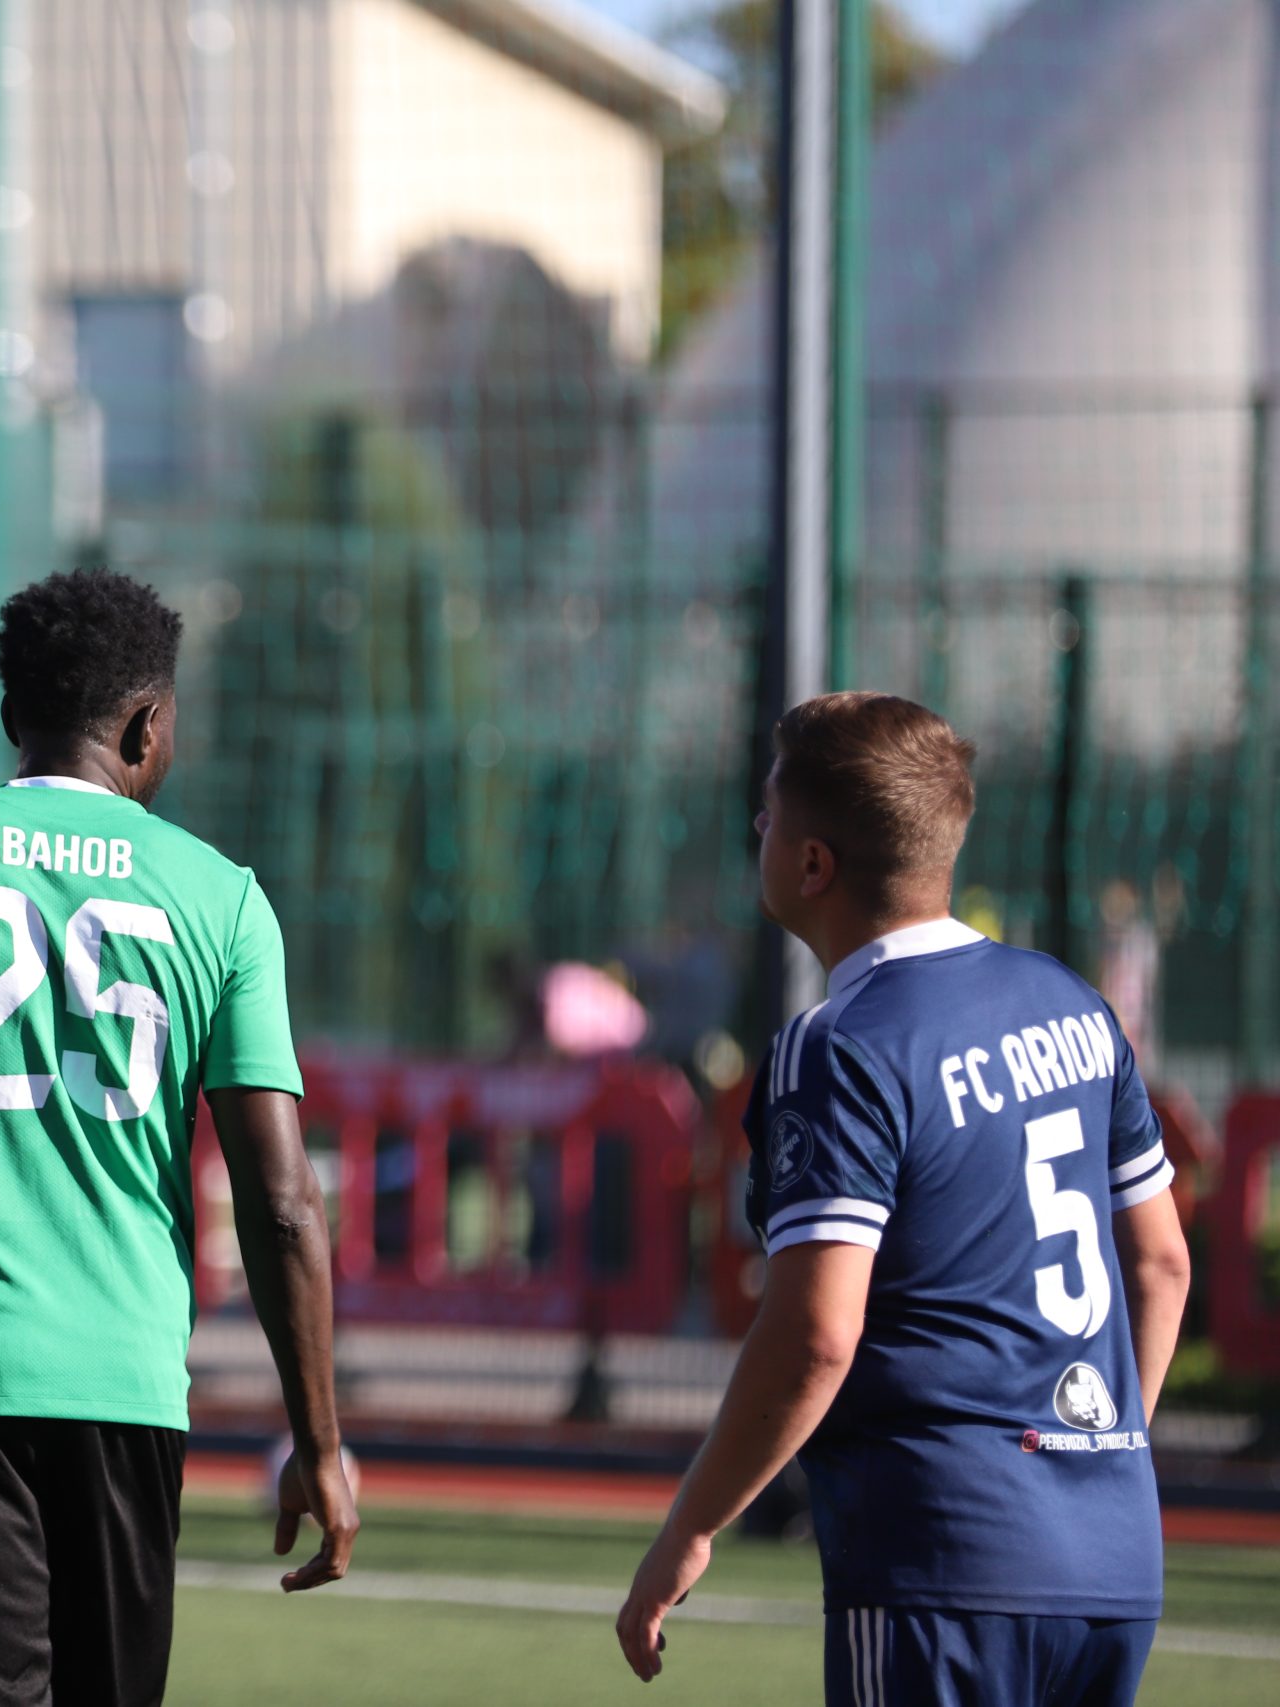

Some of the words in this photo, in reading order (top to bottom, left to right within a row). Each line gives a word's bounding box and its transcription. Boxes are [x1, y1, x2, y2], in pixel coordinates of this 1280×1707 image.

[939, 1046, 1005, 1129] FC
[1000, 1011, 1116, 1103] ARION
[1024, 1107, 1111, 1340] 5
